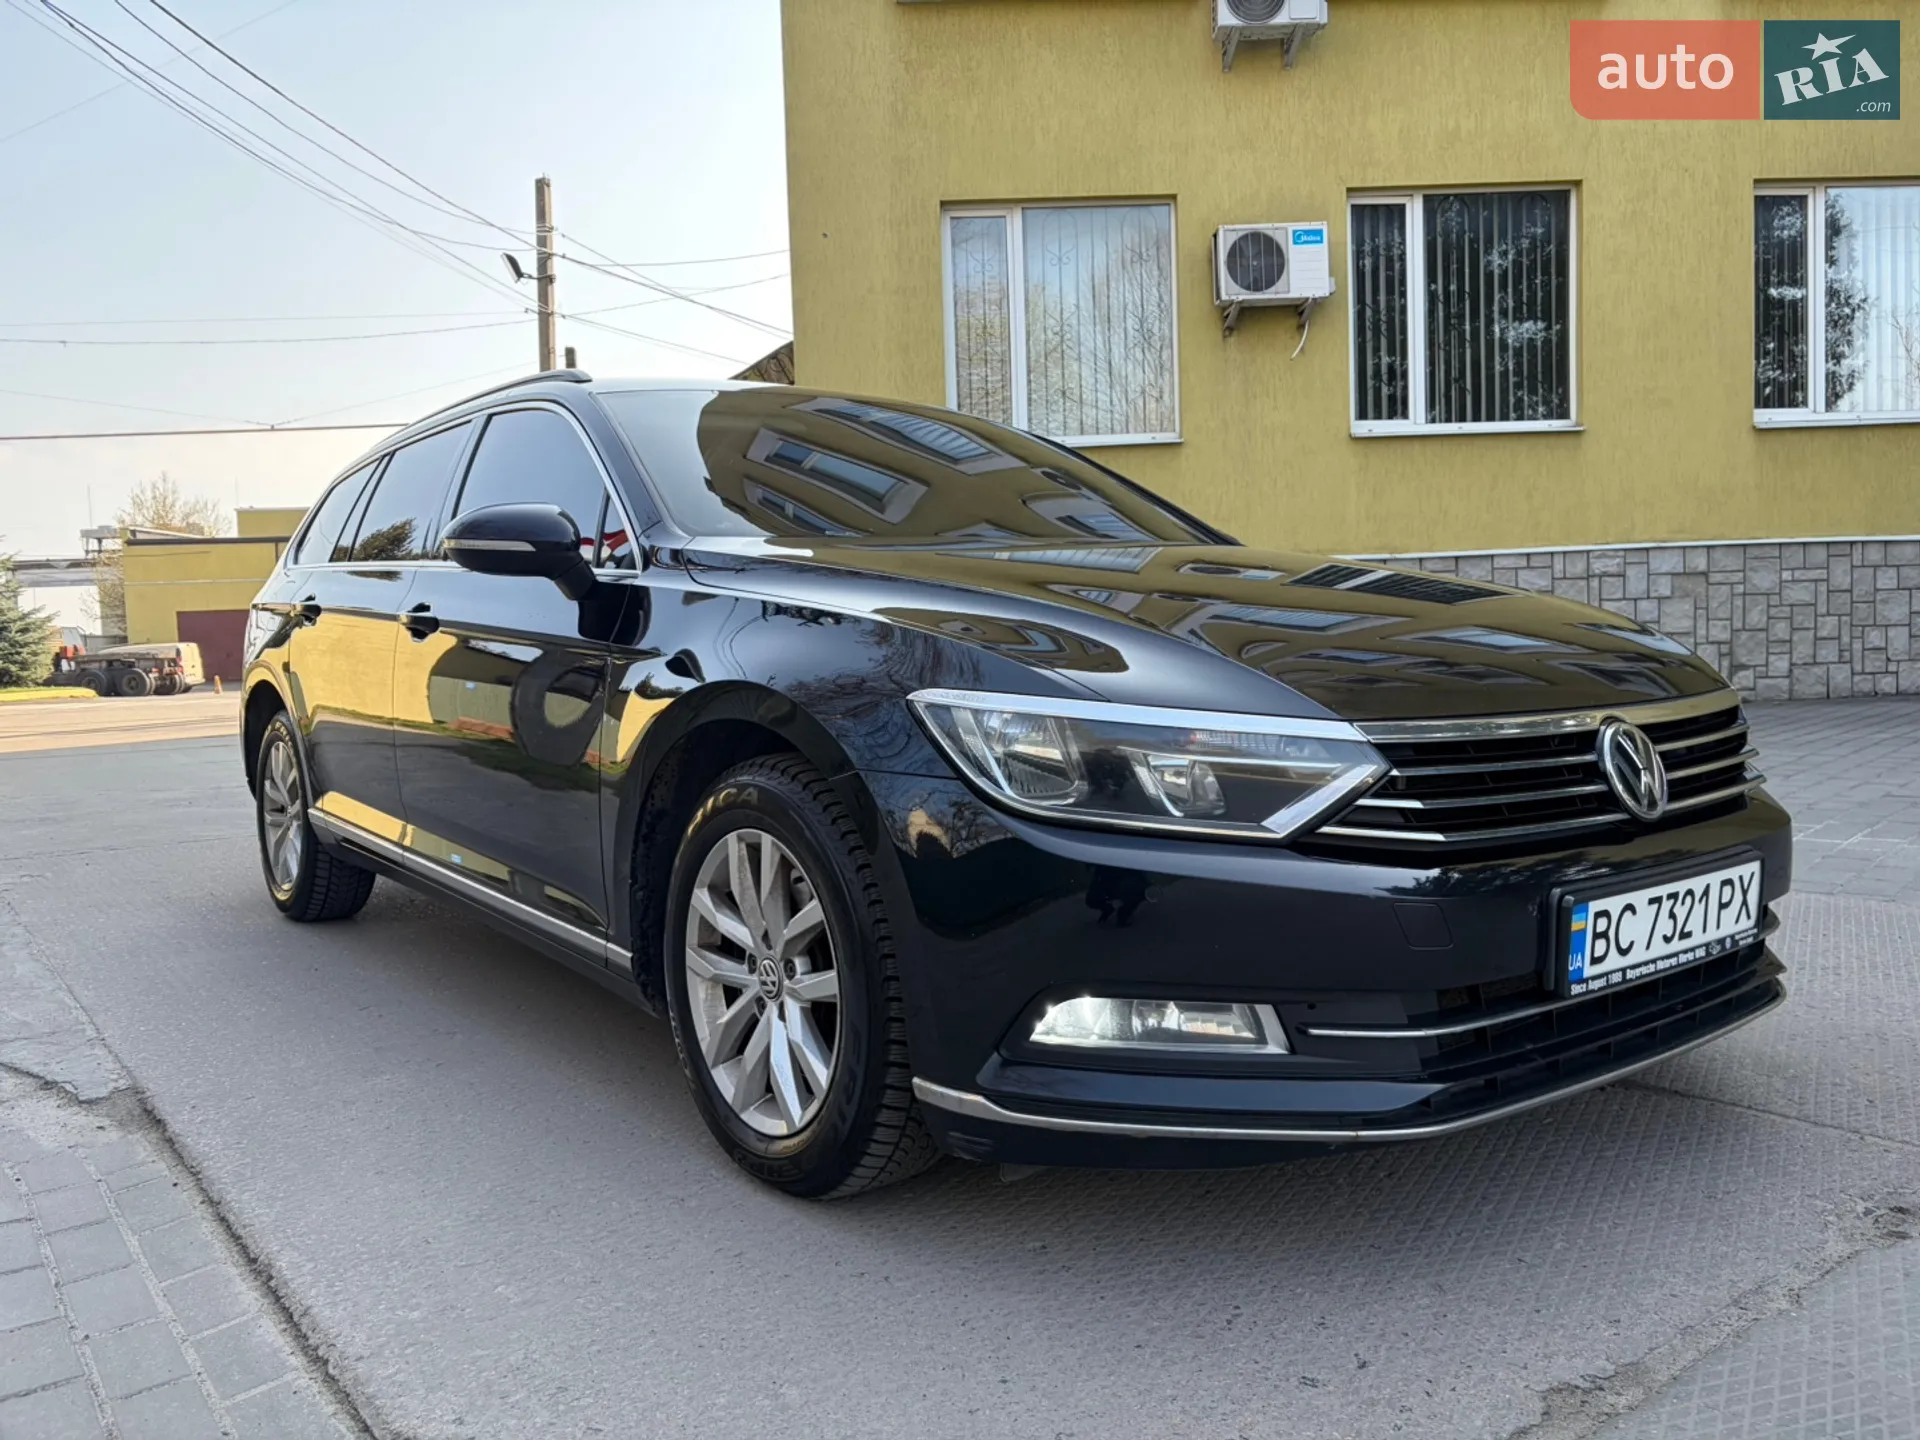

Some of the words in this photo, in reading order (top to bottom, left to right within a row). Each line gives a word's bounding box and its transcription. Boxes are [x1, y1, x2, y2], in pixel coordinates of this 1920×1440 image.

[1590, 903, 1637, 966] BC
[1645, 882, 1711, 951] 7321
[1716, 871, 1755, 931] PX
[1568, 951, 1583, 971] UA
